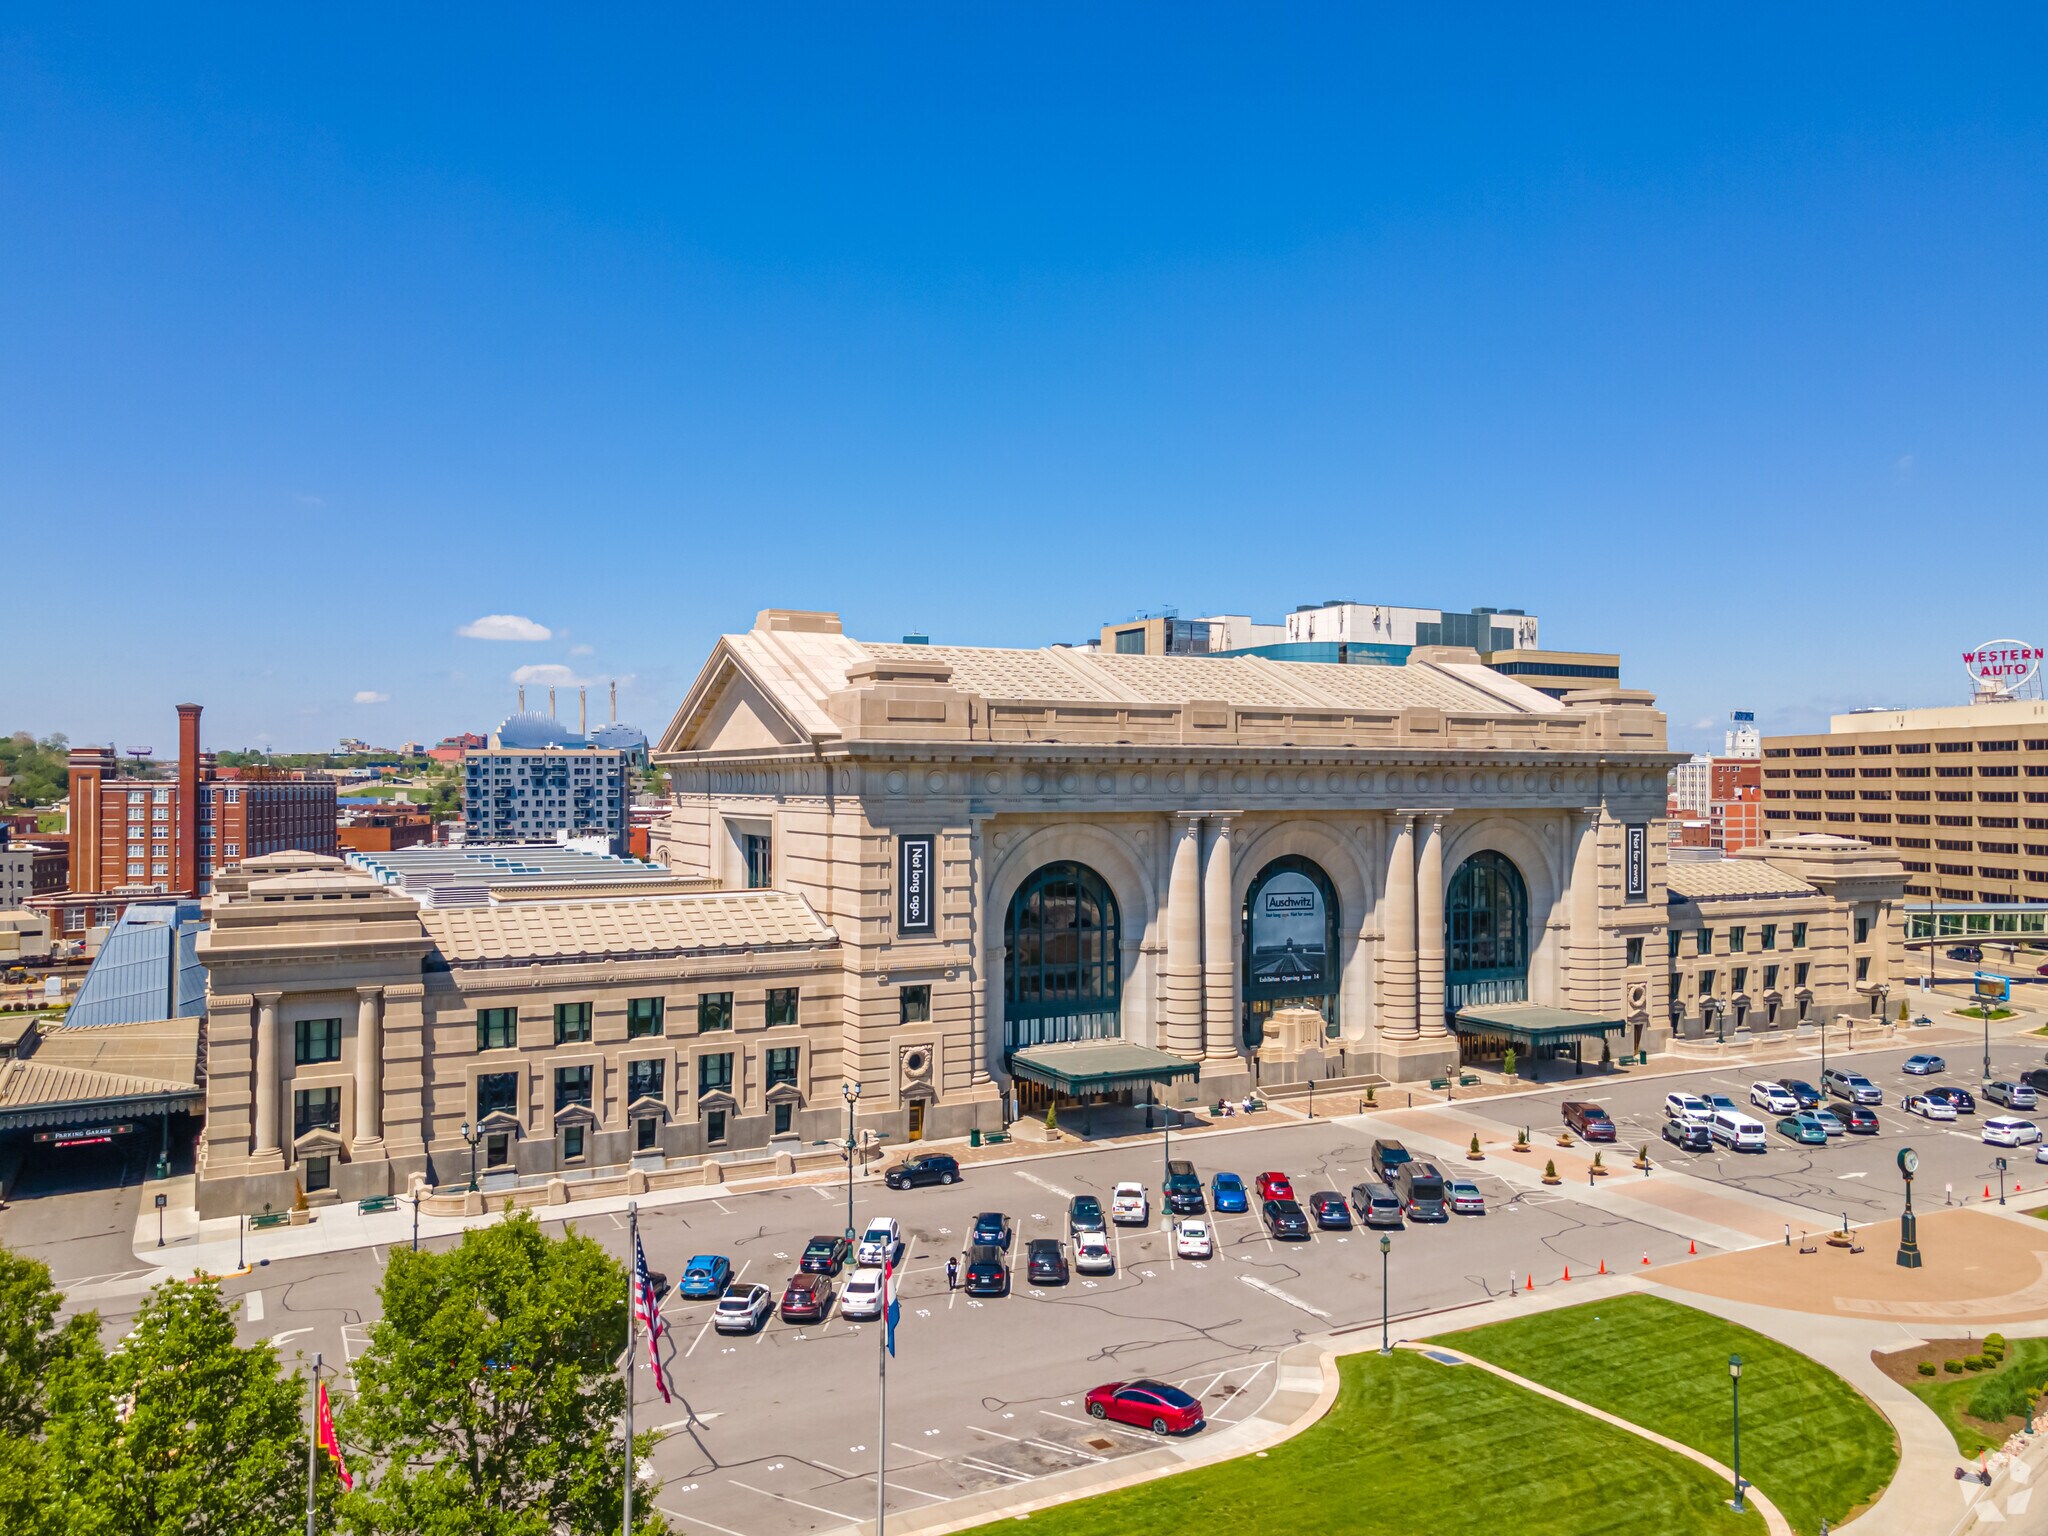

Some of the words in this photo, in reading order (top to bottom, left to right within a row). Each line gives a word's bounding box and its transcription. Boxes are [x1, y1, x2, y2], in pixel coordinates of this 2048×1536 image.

[1962, 648, 2044, 663] WESTERN
[1980, 664, 2027, 676] AUTO
[912, 848, 922, 867] Not
[909, 870, 923, 893] long
[909, 895, 919, 919] ago.
[1269, 897, 1311, 907] Auschwitz
[55, 1131, 84, 1139] PARKING
[85, 1128, 112, 1136] GARAGE
